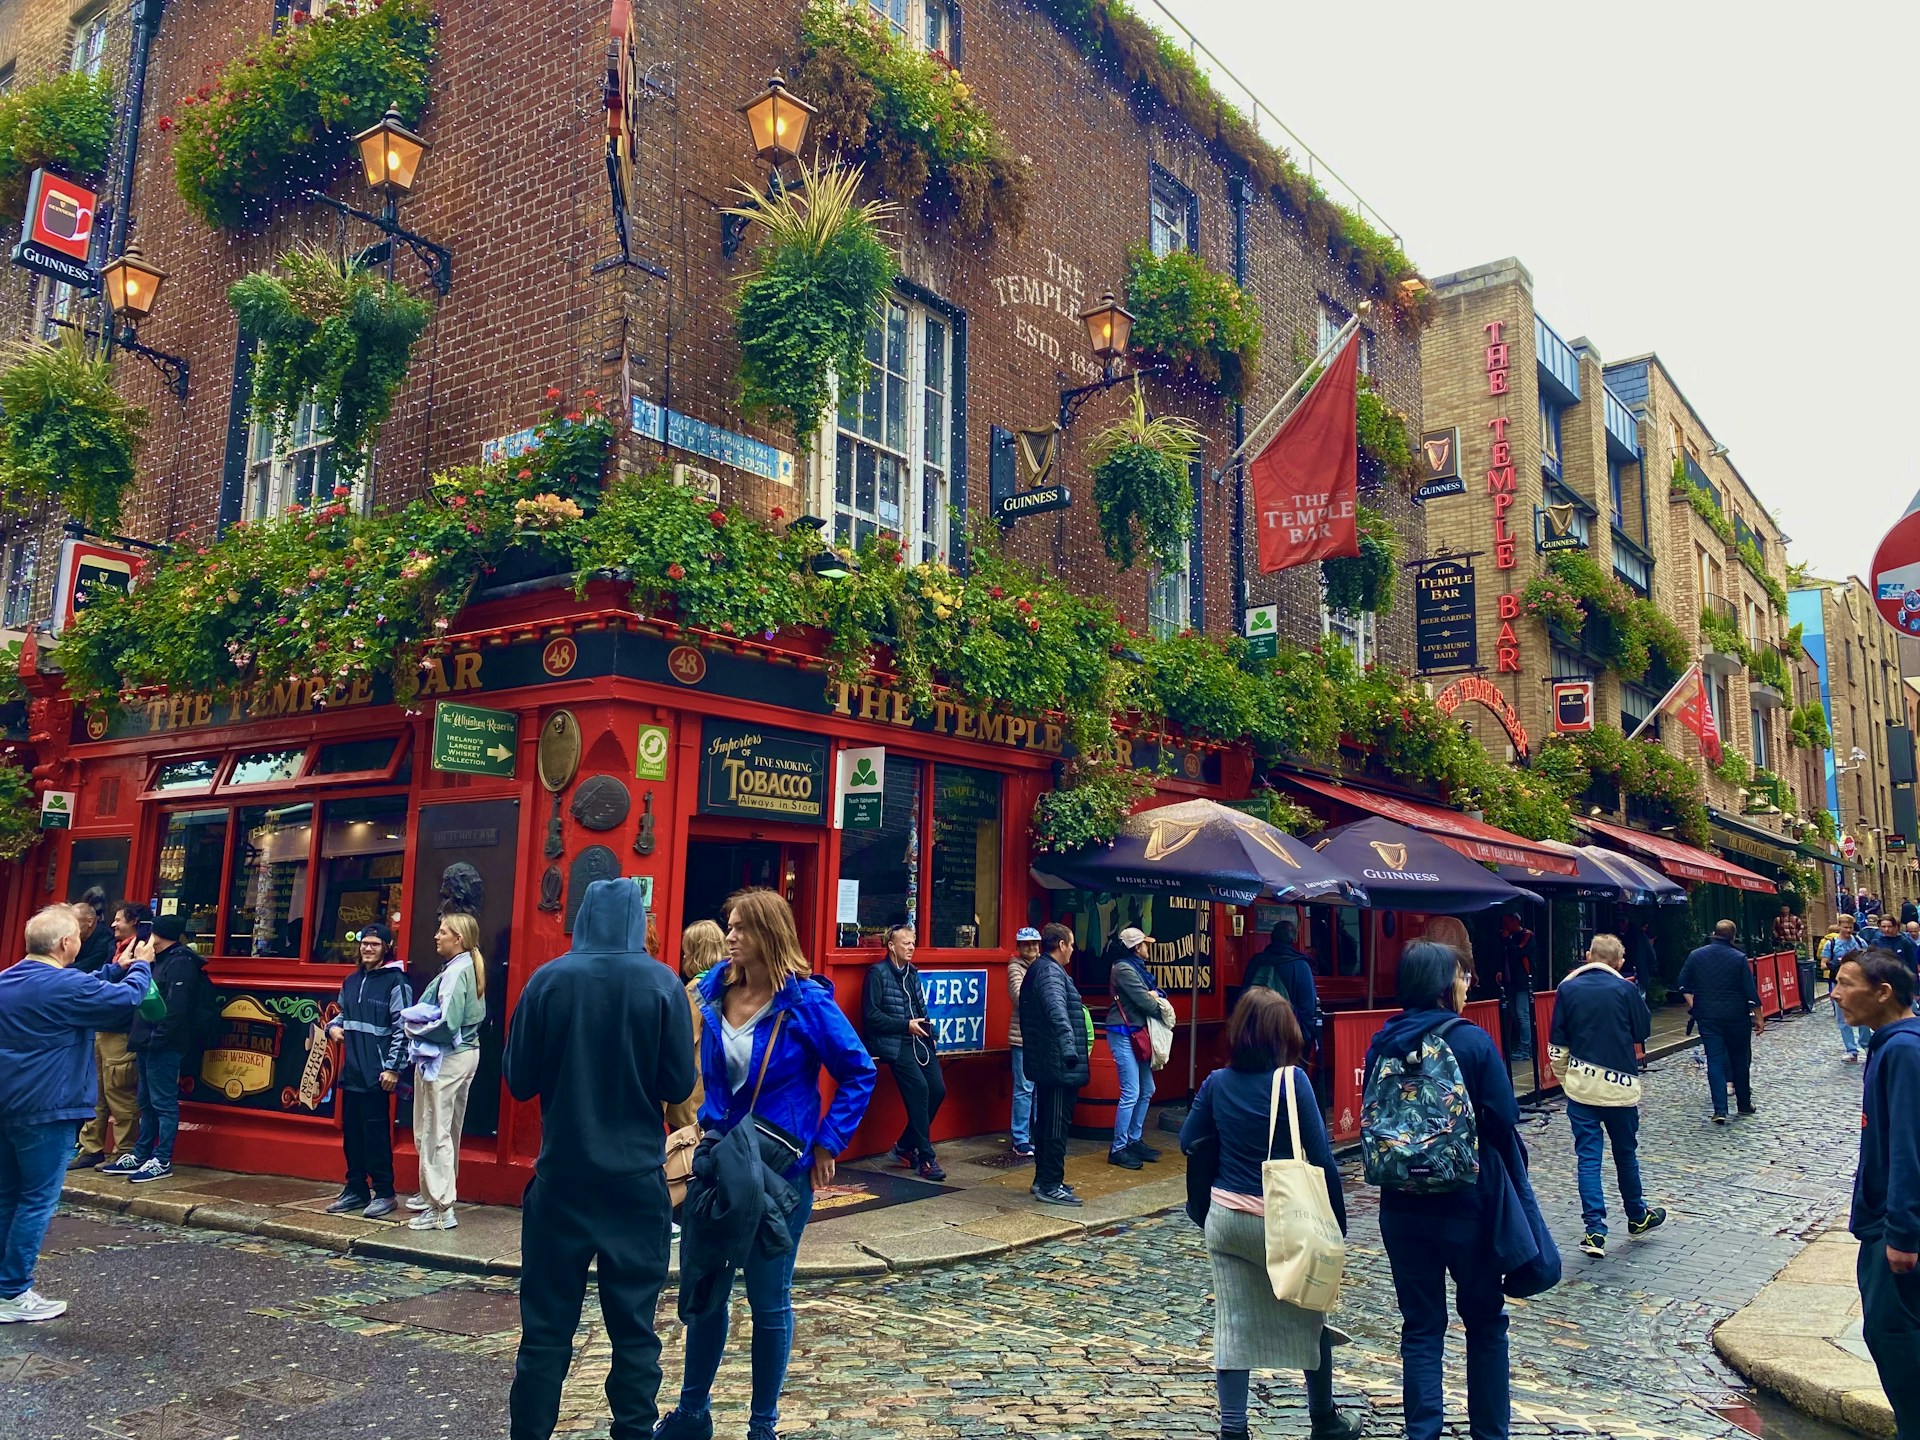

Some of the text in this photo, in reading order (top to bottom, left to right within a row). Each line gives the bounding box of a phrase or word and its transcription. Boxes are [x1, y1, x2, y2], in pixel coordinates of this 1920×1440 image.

[23, 247, 89, 281] GUINNESS
[1043, 248, 1085, 297] THE
[991, 275, 1081, 325] TEMPLE
[1484, 320, 1510, 396] THE
[669, 416, 689, 432] LÁNA
[693, 427, 704, 436] AN
[747, 443, 768, 460] THEAS
[739, 454, 771, 475] SOUTH
[1419, 481, 1461, 496] GUINNESS
[1486, 417, 1517, 570] TEMPLE
[1004, 489, 1058, 511] GUINNESS
[1292, 493, 1329, 508] THE
[1263, 501, 1354, 528] TEMPLE
[1289, 523, 1333, 544] BAR
[1541, 538, 1578, 549] GUINNESS
[1436, 567, 1454, 576] THE
[1418, 574, 1473, 590] TEMPLE
[1431, 588, 1460, 601] BAR
[1420, 613, 1472, 625] BEER GARDEN
[1495, 594, 1522, 673] BAR
[548, 641, 571, 670] 48
[1423, 641, 1471, 652] LIVE MUSIC
[1434, 651, 1459, 660] DAILY
[675, 653, 698, 676] 48
[147, 694, 213, 732] THE
[834, 682, 914, 727] THE
[933, 700, 1064, 753] TEMPLE
[1436, 677, 1528, 757] THE TEMPLE BAR
[441, 711, 515, 734] The Whiskey Reserve
[446, 734, 484, 745] IRELAND'S
[449, 742, 481, 751] LARGEST
[708, 733, 762, 758] Importers
[441, 755, 486, 766] COLLECTION
[447, 748, 480, 758] WHISKEY
[741, 748, 752, 757] OF
[643, 762, 661, 770] Official
[754, 756, 812, 773] FINE SMOKING
[721, 757, 812, 801] TOBACCO
[739, 795, 818, 813] Always in Stock
[942, 785, 996, 806] TEMPLE BAR
[1476, 843, 1490, 856] THE
[1491, 845, 1513, 861] TEMPLE
[1115, 876, 1147, 885] RAISING
[1149, 877, 1165, 886] THE
[1167, 878, 1181, 887] BAR
[1363, 868, 1440, 882] GUINNESS
[1219, 886, 1258, 902] GUINNESS
[930, 1016, 983, 1043] KEY
[251, 1035, 273, 1053] BAR
[209, 1051, 266, 1068] IRISH WHISKEY
[301, 1042, 319, 1094] EDITION
